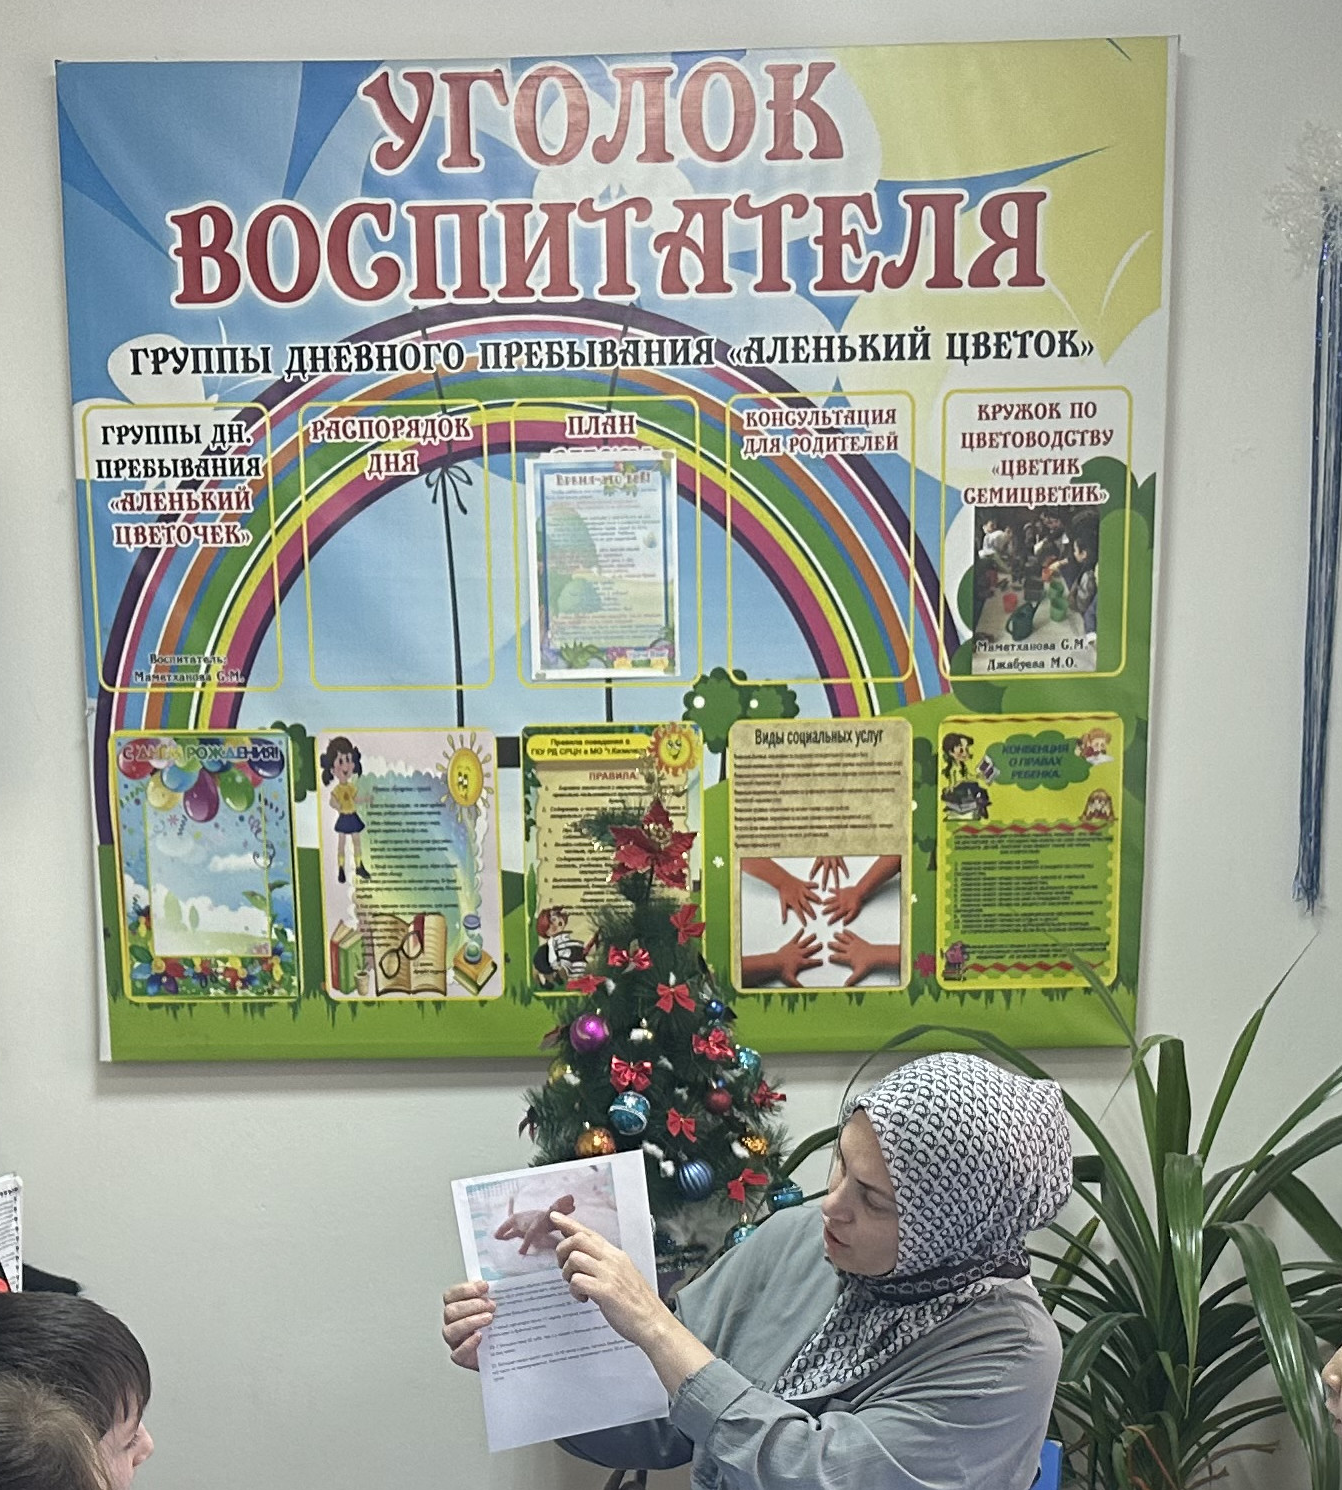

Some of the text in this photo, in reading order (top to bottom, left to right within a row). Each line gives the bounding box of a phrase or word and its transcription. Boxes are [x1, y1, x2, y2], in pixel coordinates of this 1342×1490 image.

[363, 61, 846, 172] УГОЛОК
[169, 190, 1048, 304] ВОСПИТАТЕЛЯ
[130, 326, 1095, 380] ГРУППЫ ДНЕВНОГО ПРЕБЫВАНИЯ «АЛЕНЬКИЙ ЦВЕТОК»
[746, 409, 897, 428] КОНСУЛЬТАЦИЯ
[977, 402, 1097, 421] КРУЖОК ПО
[101, 422, 252, 449] ГРУППЫ ДН.
[311, 417, 472, 441] РАСПОРЯДОК
[568, 415, 635, 435] ПЛАН
[743, 431, 898, 456] ДЛЯ РОДИТЕЛЕЙ
[961, 429, 1114, 451] ЦВЕТОВОДСТВУ
[96, 457, 261, 479] ПРЕБЫВАНИЯ
[367, 452, 418, 480] ДНЯ
[991, 458, 1081, 479] «ЦВЕТИК
[110, 486, 251, 512] «АЛЕНЬКИЙ
[963, 485, 1108, 507] СЕМИЦВЕТИК»
[114, 523, 251, 547] ЦВЕТОЧЕК»
[149, 653, 227, 665] Воспитатель:
[755, 728, 884, 748] Виды социальных услуг
